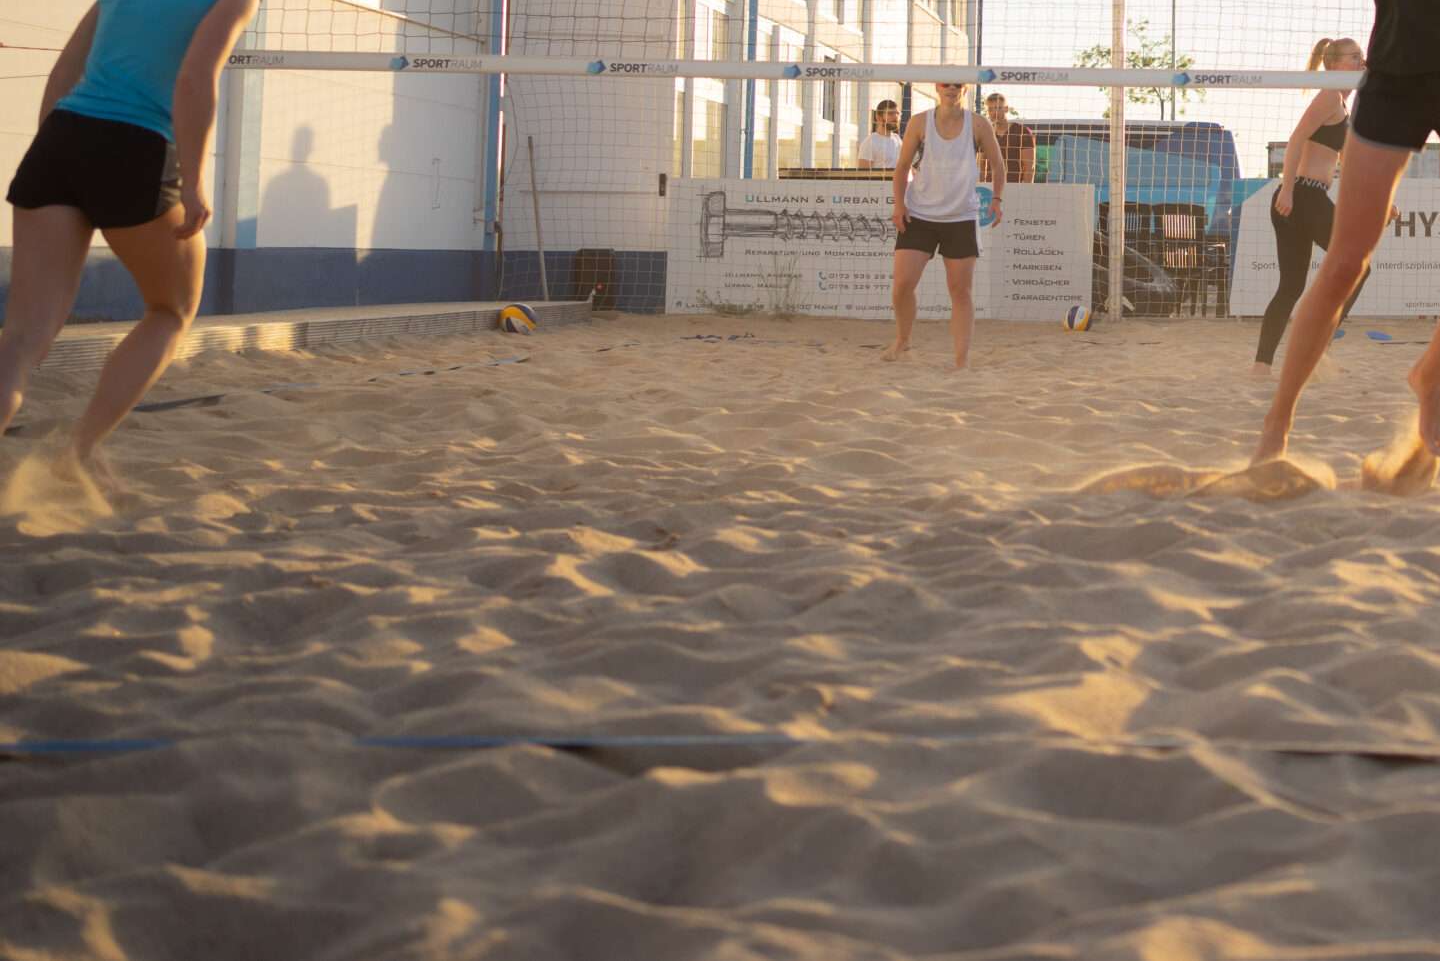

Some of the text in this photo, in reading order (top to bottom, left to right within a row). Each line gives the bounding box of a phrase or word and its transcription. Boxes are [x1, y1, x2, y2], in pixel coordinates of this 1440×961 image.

[228, 54, 285, 65] ORTRAUM
[745, 194, 809, 204] ULLMANN
[815, 196, 825, 204] &
[832, 195, 879, 205] URBAN
